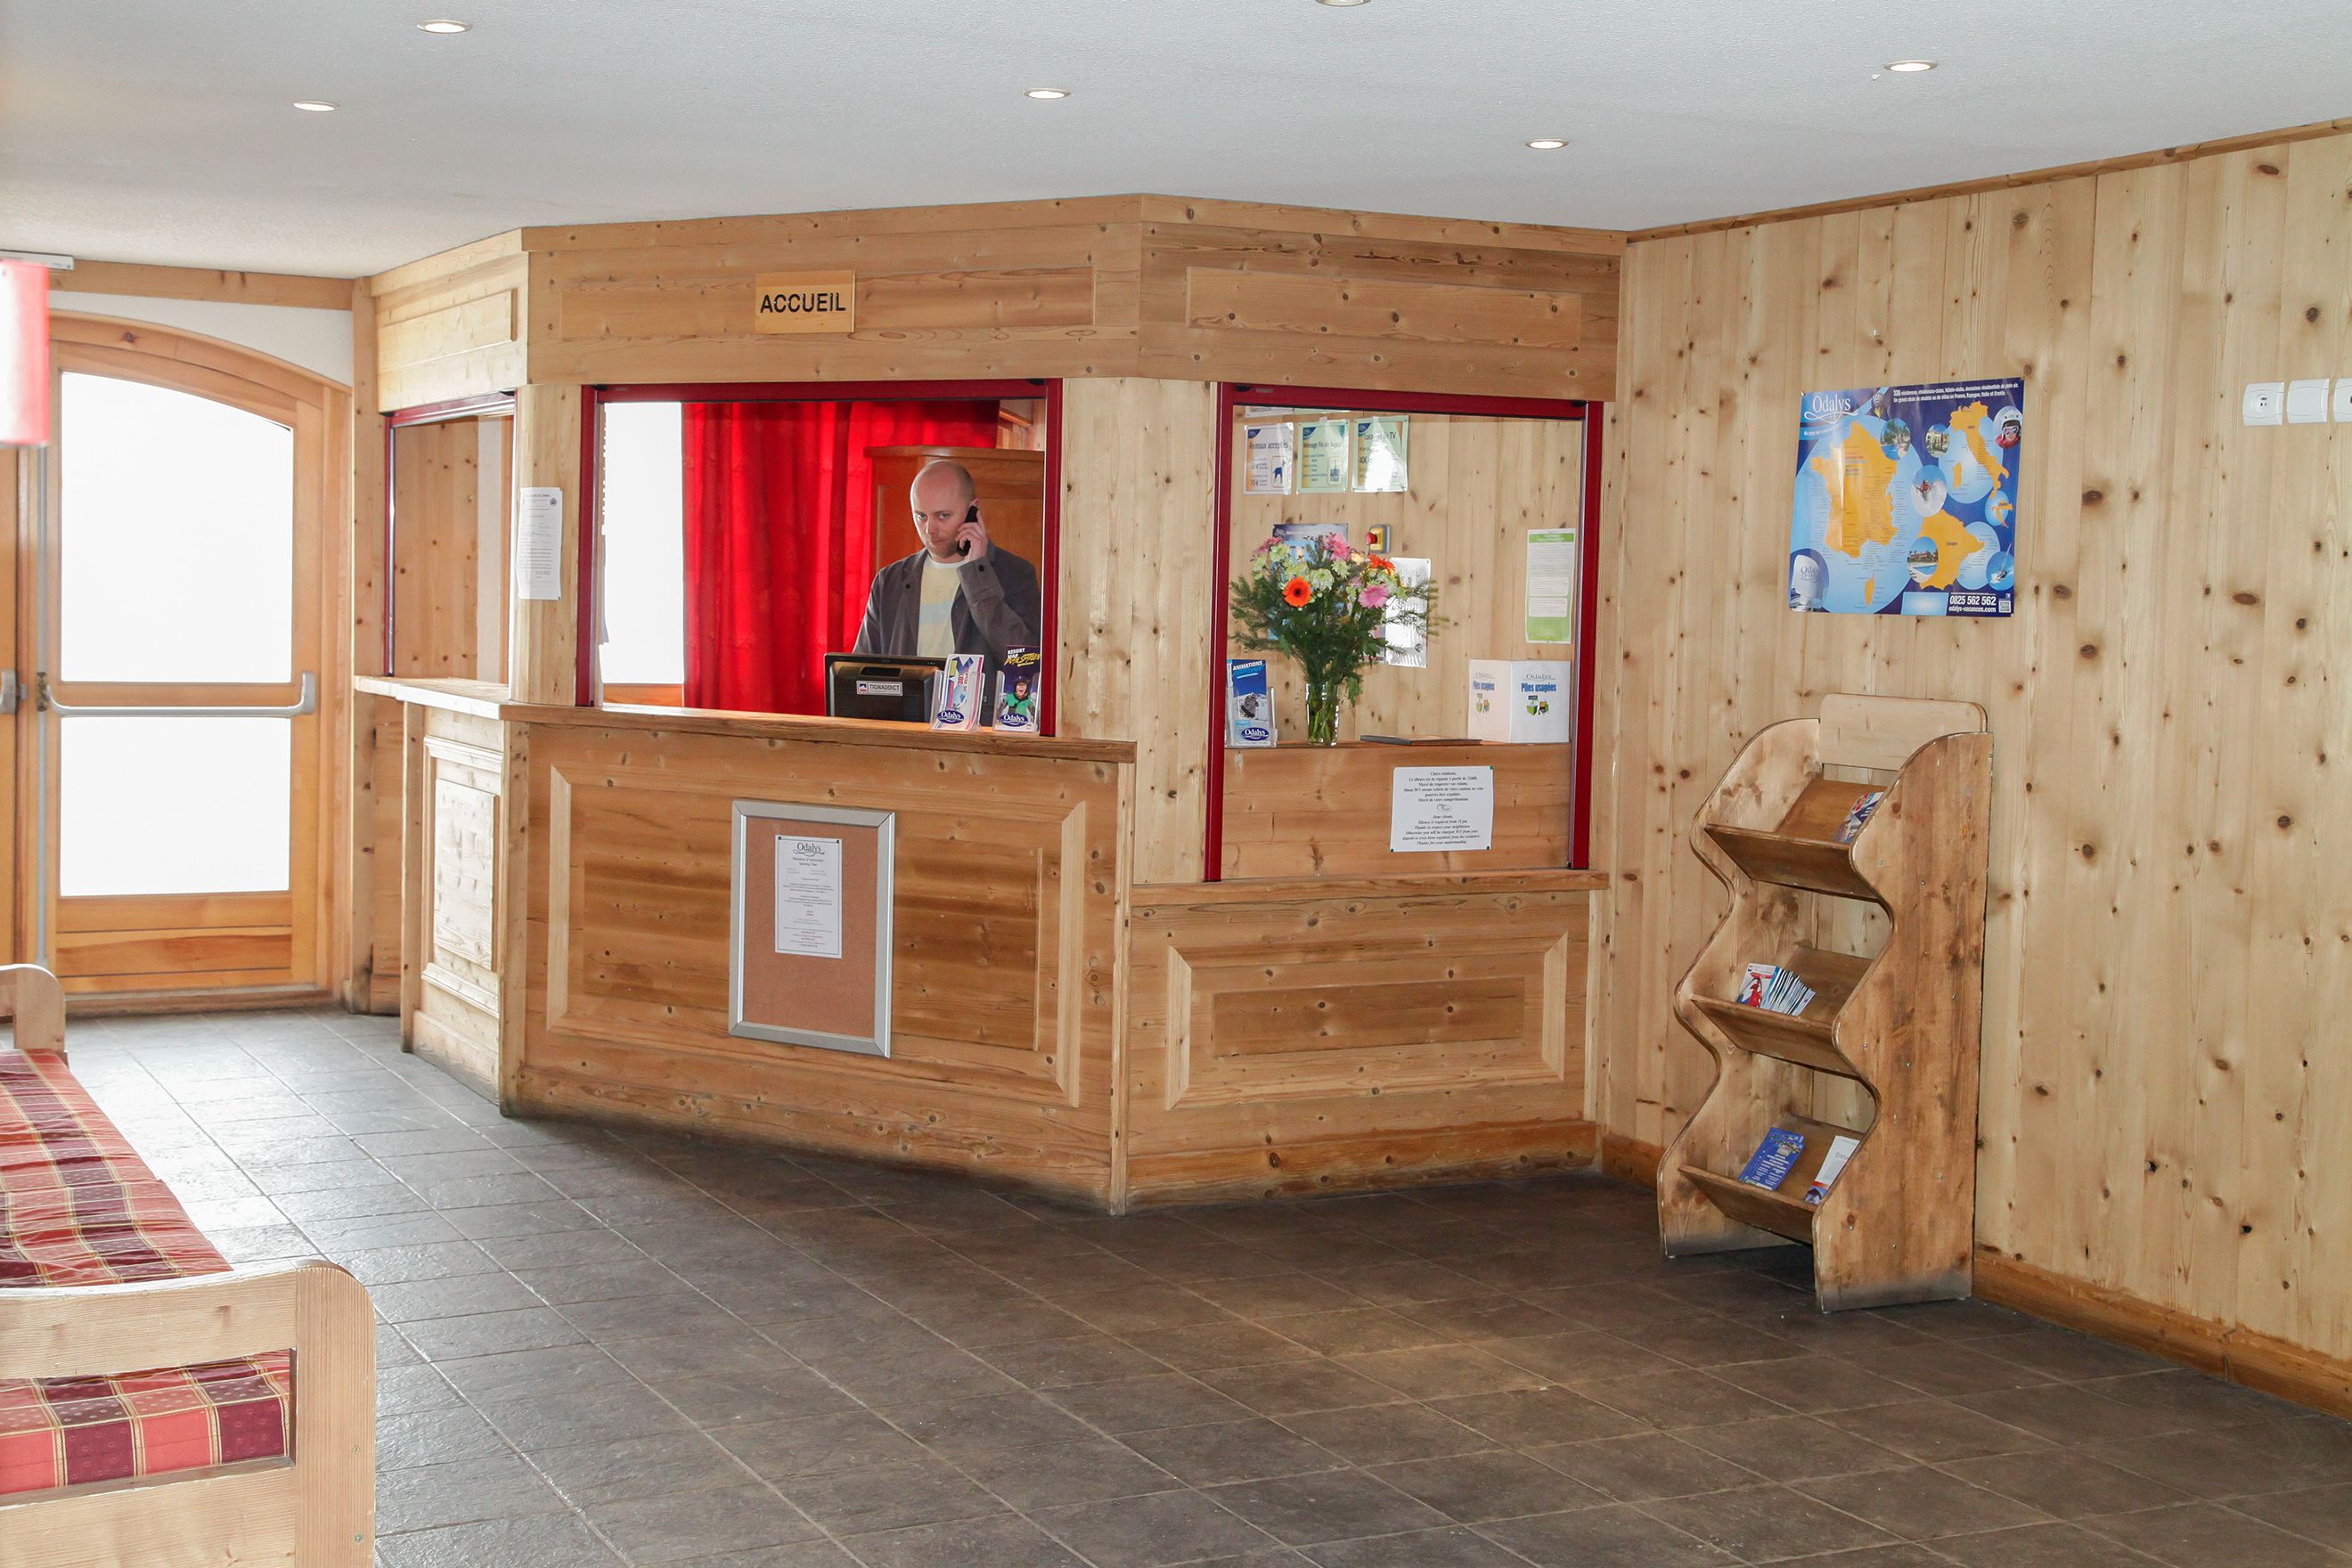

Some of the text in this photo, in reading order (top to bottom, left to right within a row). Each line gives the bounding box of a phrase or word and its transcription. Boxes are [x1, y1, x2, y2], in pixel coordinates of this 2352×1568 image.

[760, 292, 846, 314] ACCUEIL
[1812, 394, 1851, 412] Odalys
[1949, 595, 1996, 606] 0825 562 562
[1233, 660, 1263, 671] ANIMATIONS
[1521, 682, 1556, 692] Piles usagées
[941, 711, 961, 721] Odalys
[1245, 728, 1266, 737] Odalys
[797, 842, 821, 853] Odalys
